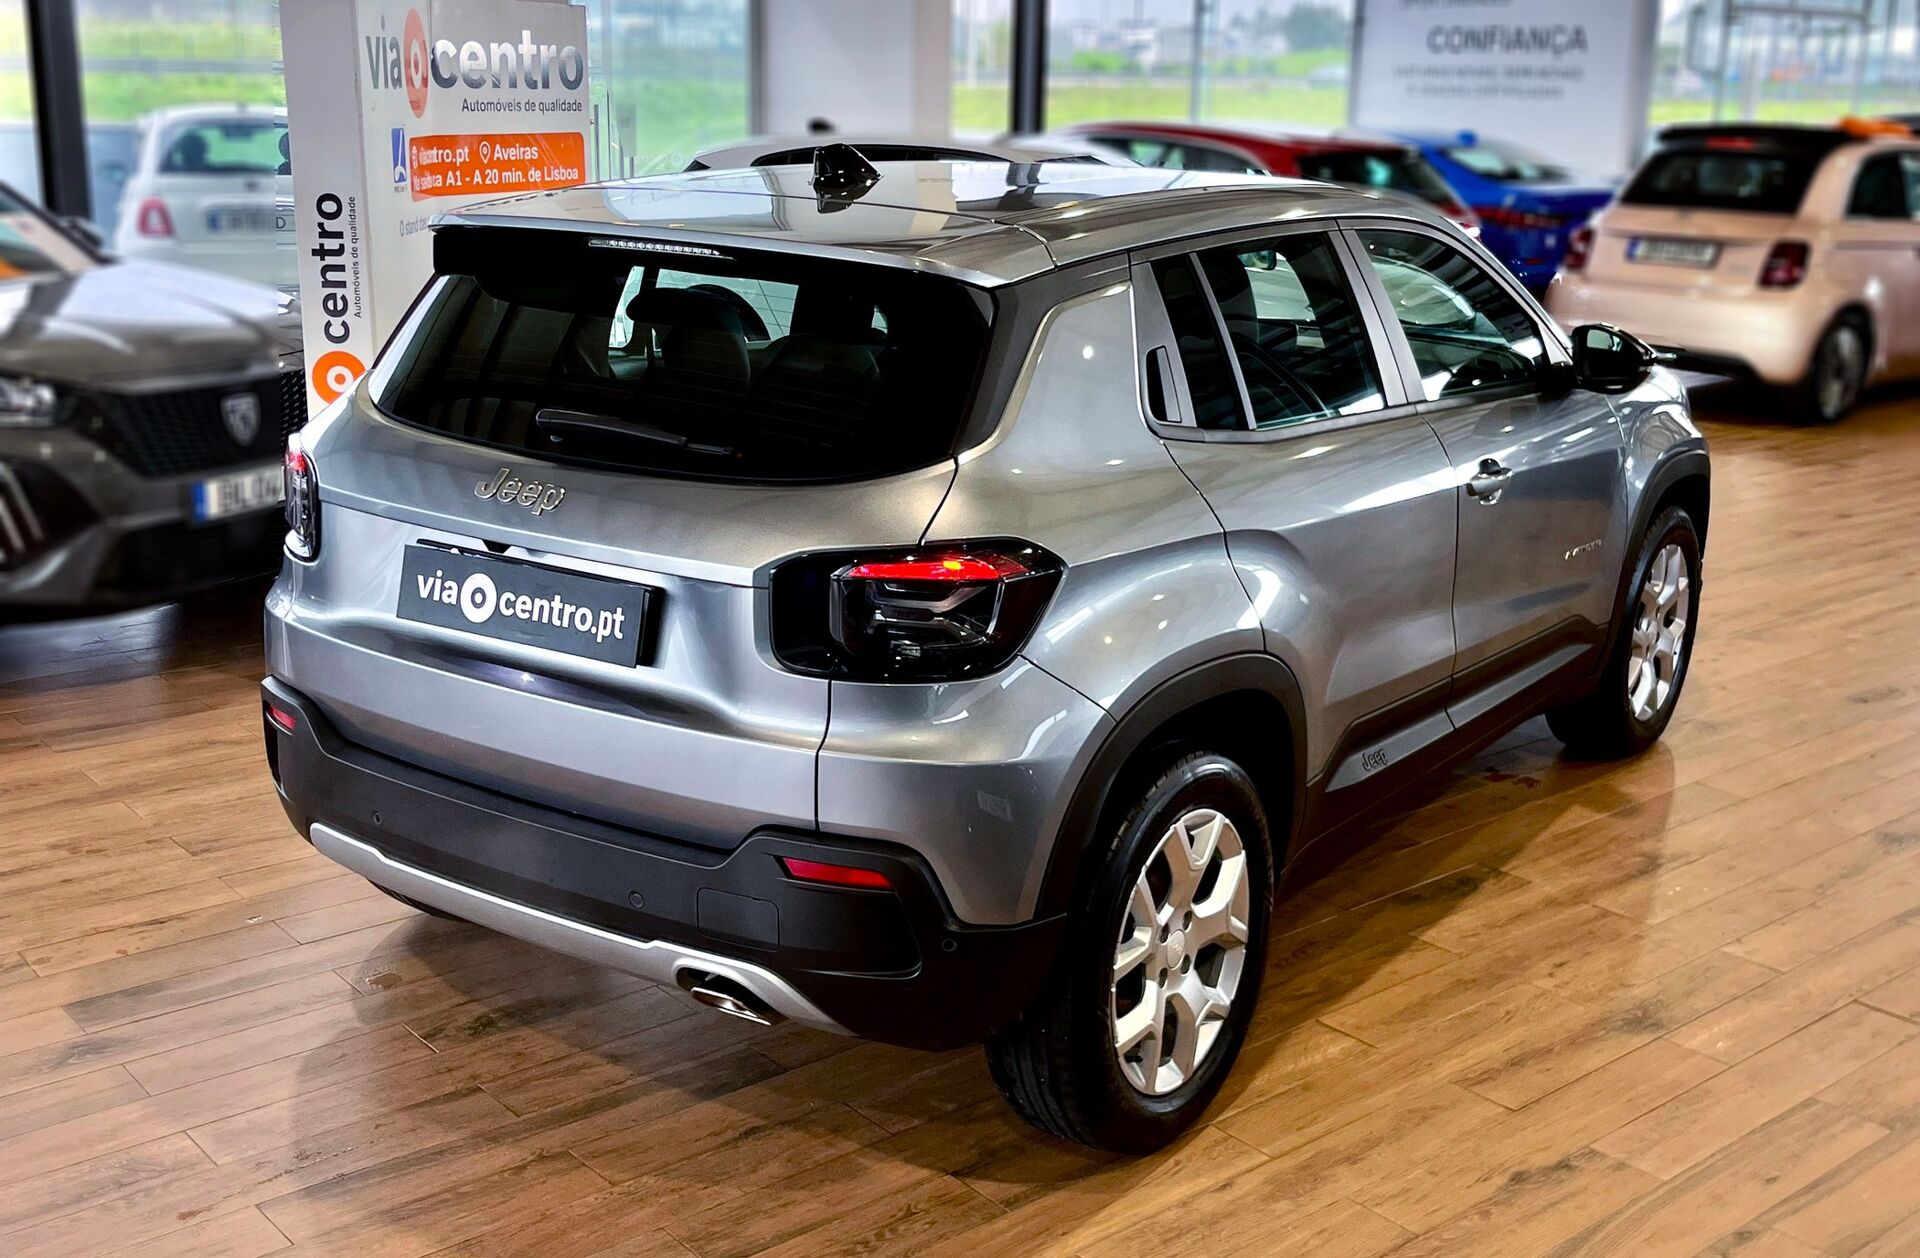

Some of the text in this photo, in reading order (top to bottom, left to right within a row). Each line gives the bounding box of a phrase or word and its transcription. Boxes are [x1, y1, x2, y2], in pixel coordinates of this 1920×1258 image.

[366, 16, 584, 90] via centro
[461, 98, 583, 115] Automóveis de qualidade
[446, 170, 462, 186] A1
[473, 169, 483, 185] A
[485, 169, 499, 185] 20
[502, 168, 524, 184] min.
[527, 167, 541, 182] de
[544, 165, 579, 181] Lisboa
[494, 144, 538, 161] Aveiras
[312, 193, 350, 344] centro
[348, 196, 362, 318] Automóveis de qualidade
[474, 468, 566, 516] Jeep
[417, 569, 625, 642] via centro.pt
